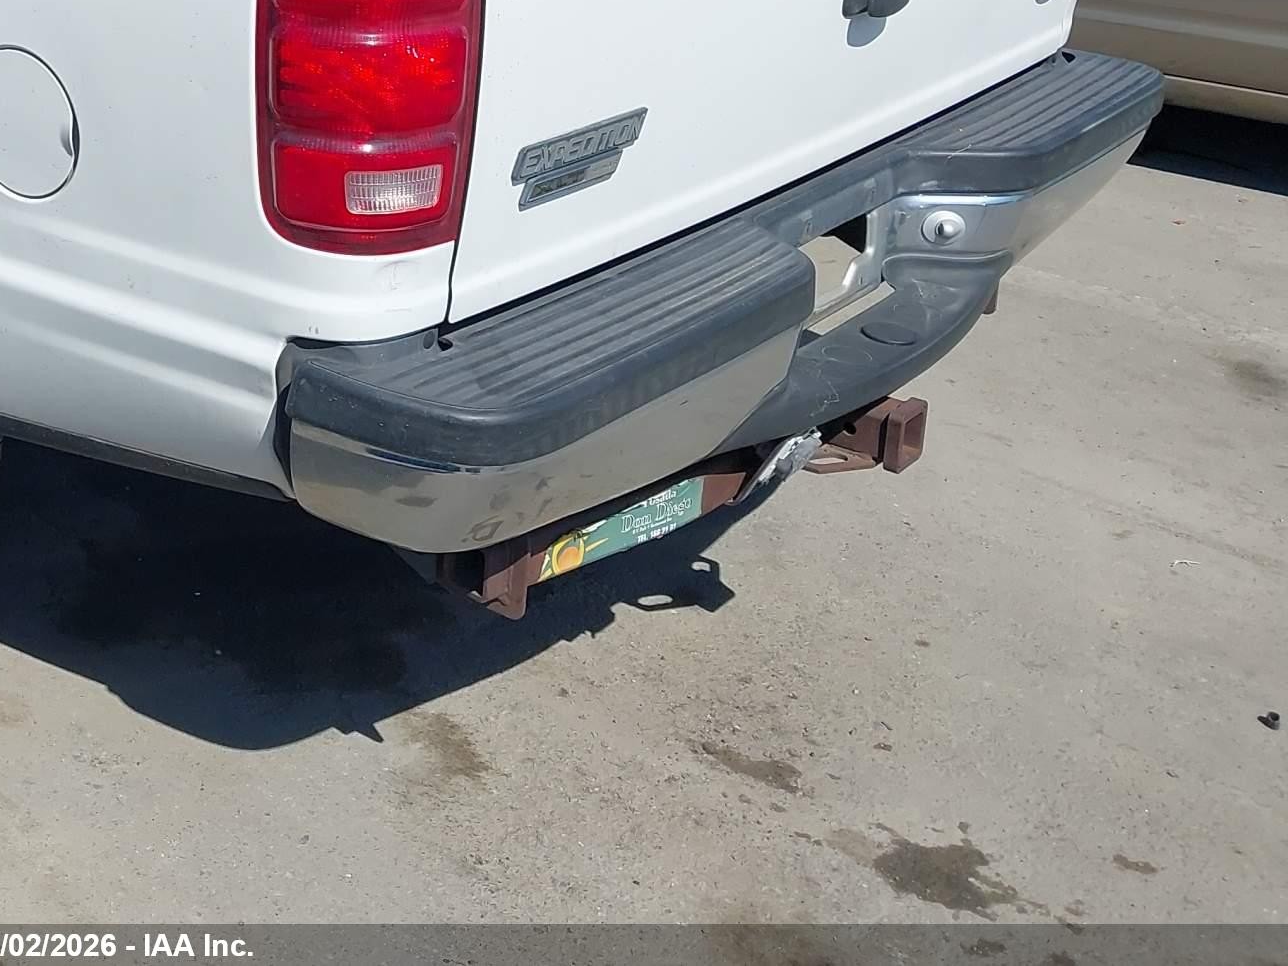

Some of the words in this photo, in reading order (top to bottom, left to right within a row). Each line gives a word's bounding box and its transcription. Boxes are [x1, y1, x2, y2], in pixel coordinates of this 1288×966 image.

[523, 115, 644, 174] EXPEDITION
[620, 513, 652, 533] Don
[655, 497, 692, 522] Diego
